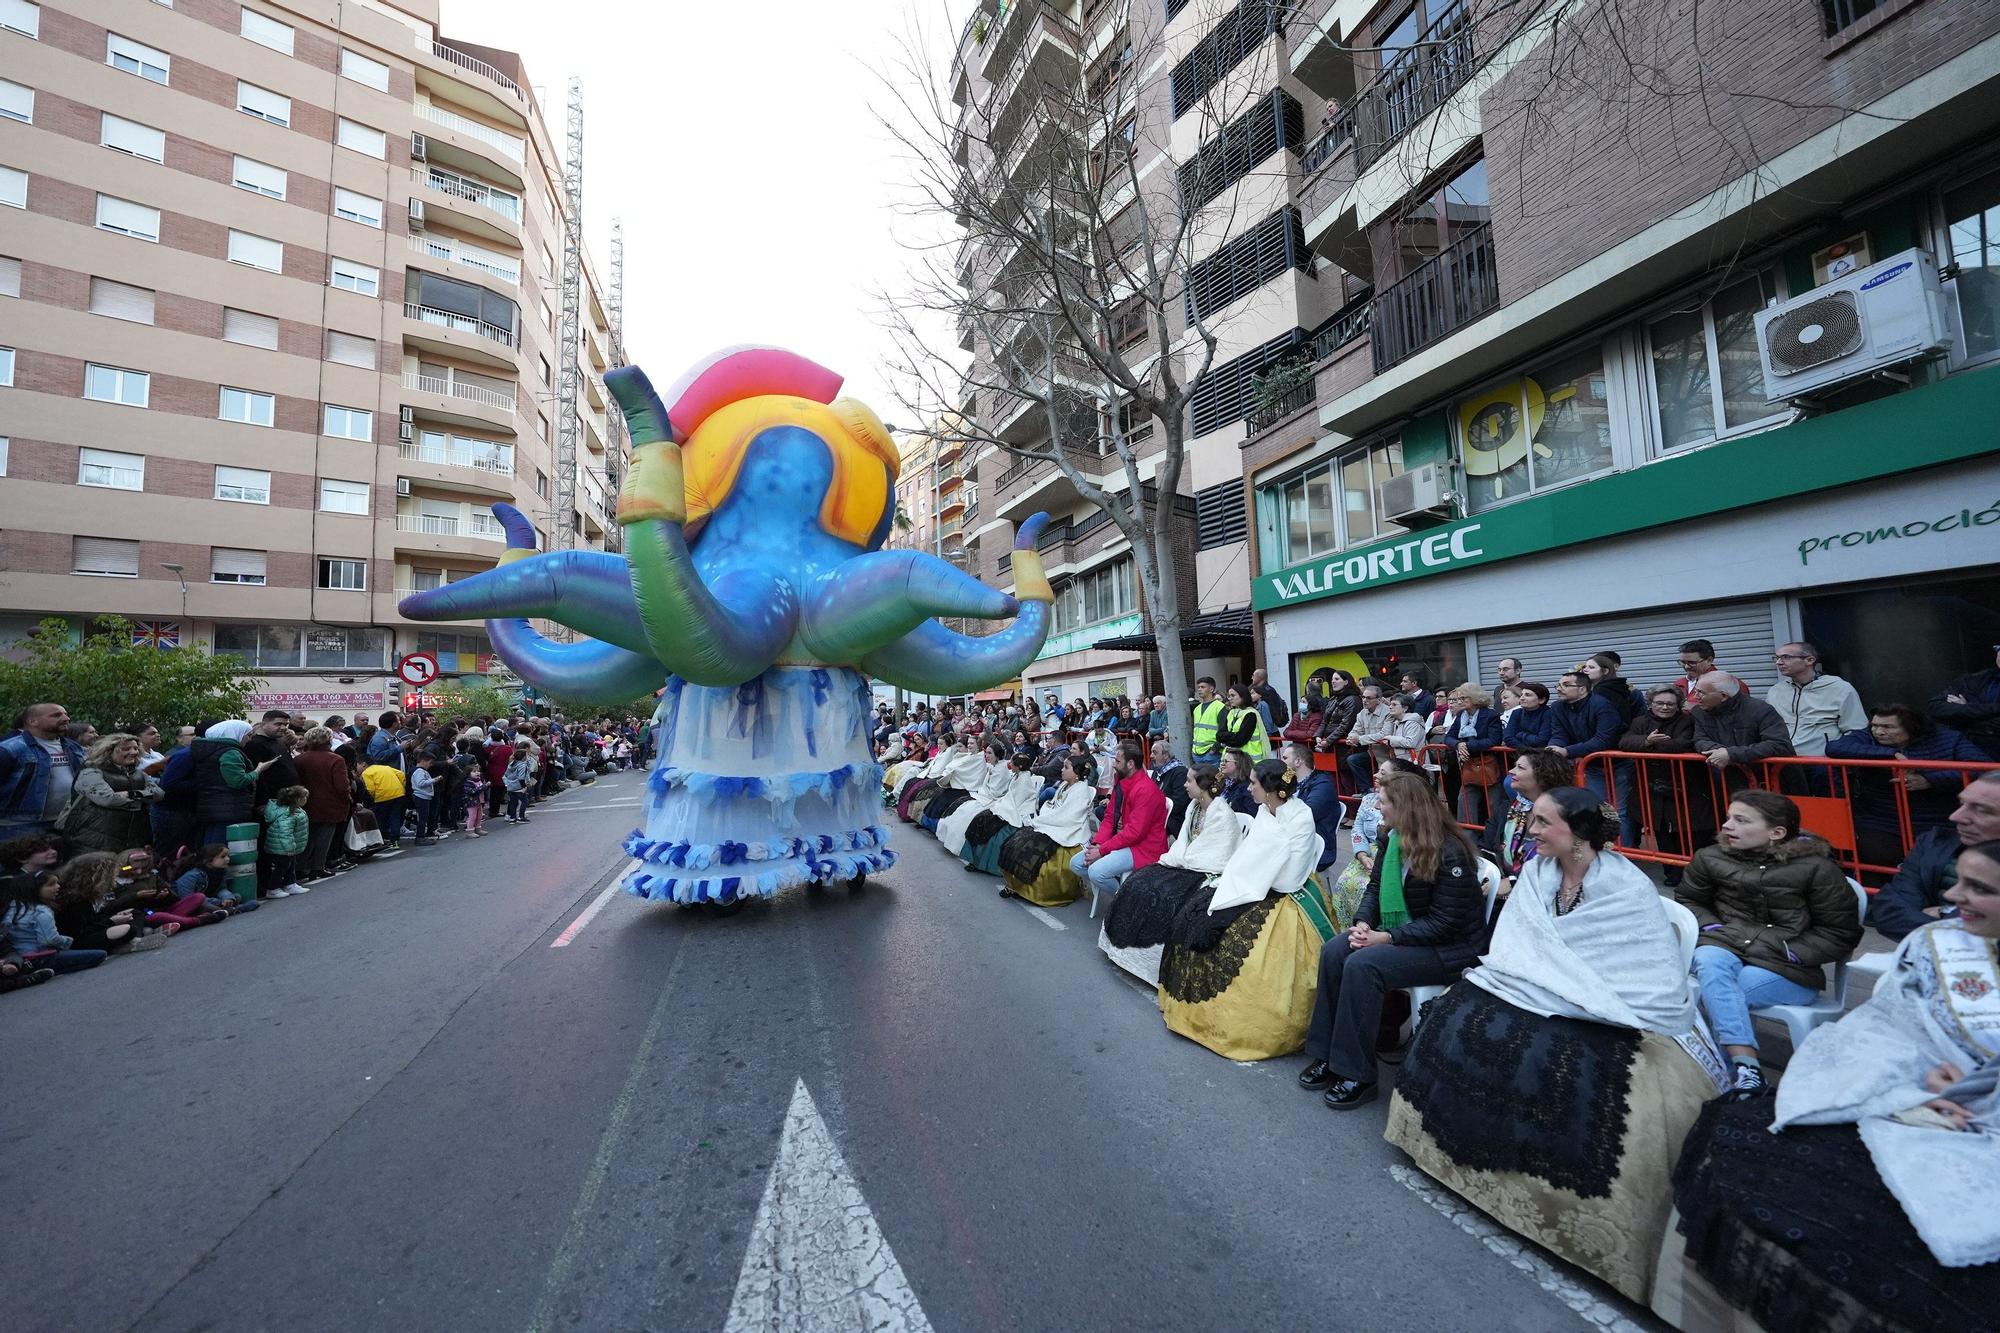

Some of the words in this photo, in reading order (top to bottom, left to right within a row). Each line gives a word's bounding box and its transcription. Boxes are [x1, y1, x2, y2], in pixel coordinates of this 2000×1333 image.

[1864, 265, 1907, 288] SAMSUNG
[1272, 523, 1483, 600] VALFORTEC
[1798, 500, 2000, 565] promoció
